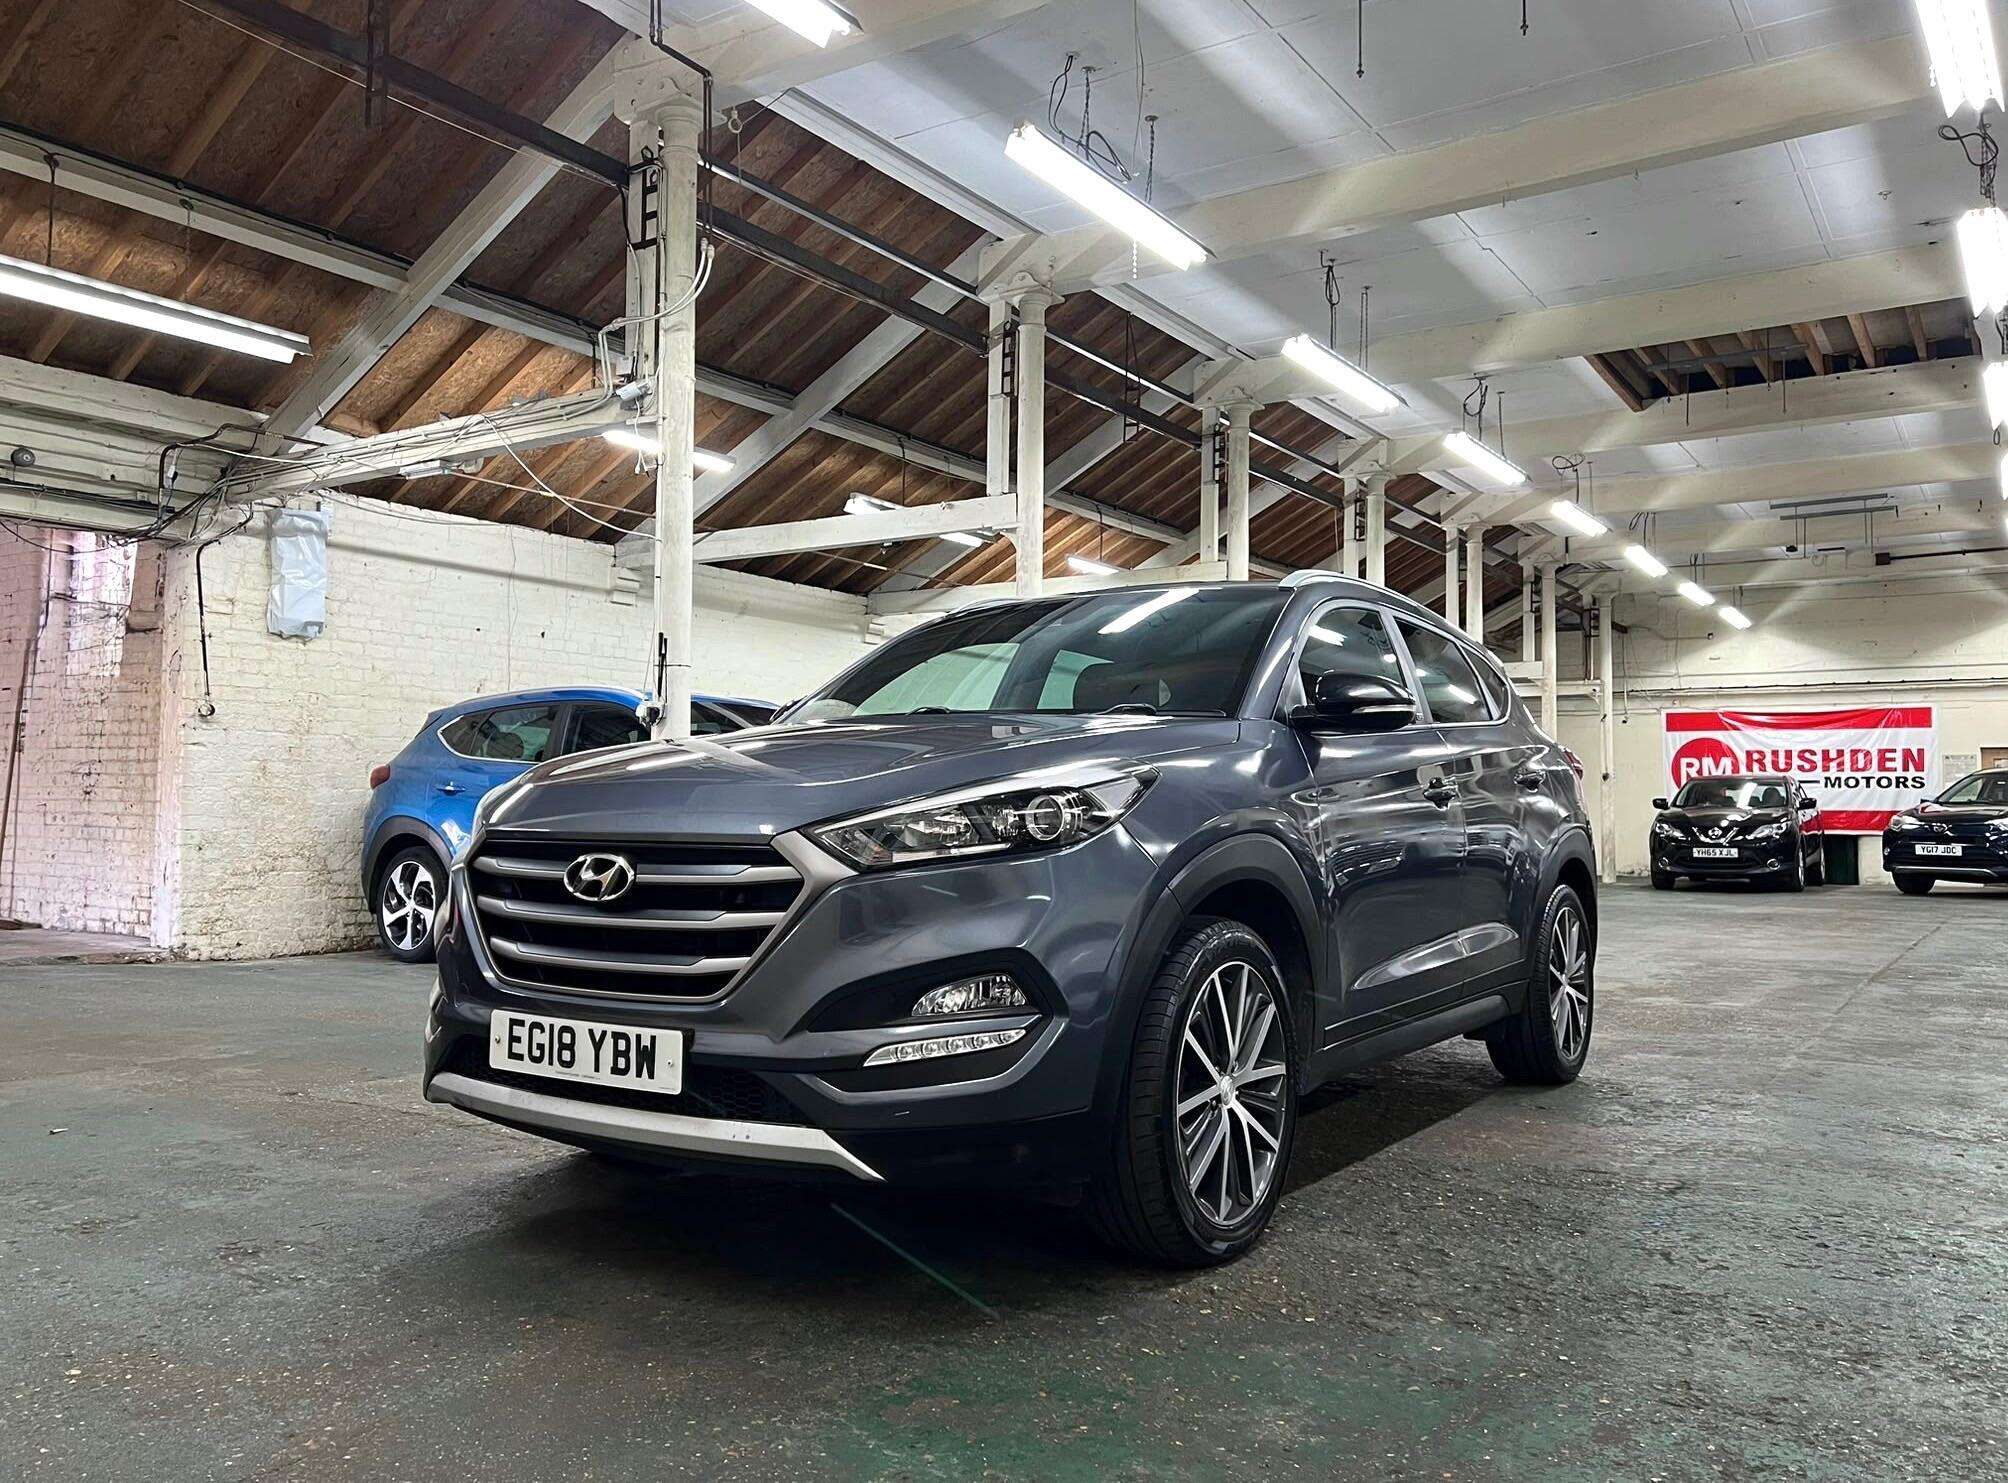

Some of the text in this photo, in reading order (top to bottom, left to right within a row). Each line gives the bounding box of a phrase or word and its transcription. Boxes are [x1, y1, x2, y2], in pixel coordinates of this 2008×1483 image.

[1680, 756, 1733, 783] RM
[1745, 747, 1925, 773] RUSHDEN
[1823, 775, 1926, 789] MOTORS
[507, 1017, 657, 1080] EG18 YBW
